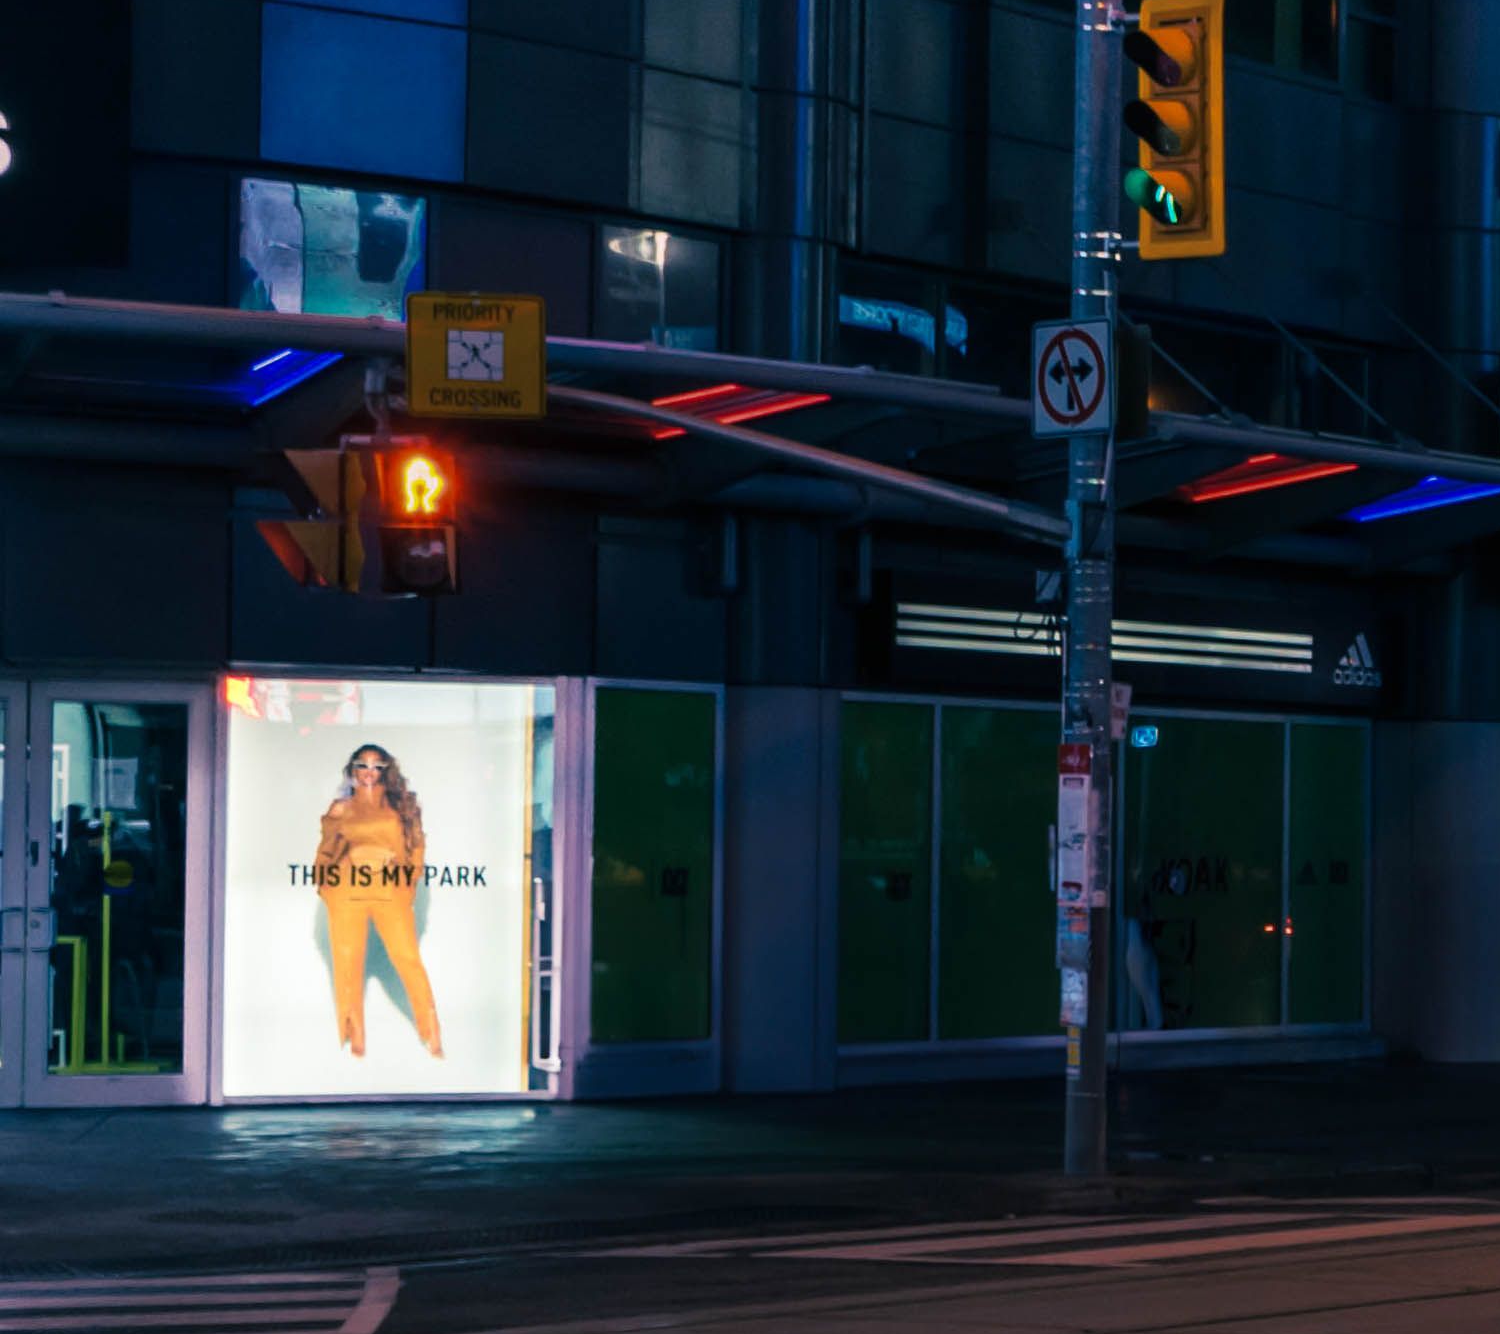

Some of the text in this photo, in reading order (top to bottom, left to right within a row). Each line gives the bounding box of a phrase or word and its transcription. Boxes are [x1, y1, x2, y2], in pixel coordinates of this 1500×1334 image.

[432, 302, 516, 323] PRIORITY
[429, 386, 524, 409] CROSSING
[1333, 667, 1383, 688] adidas
[287, 864, 487, 887] THIS IS MY PARK
